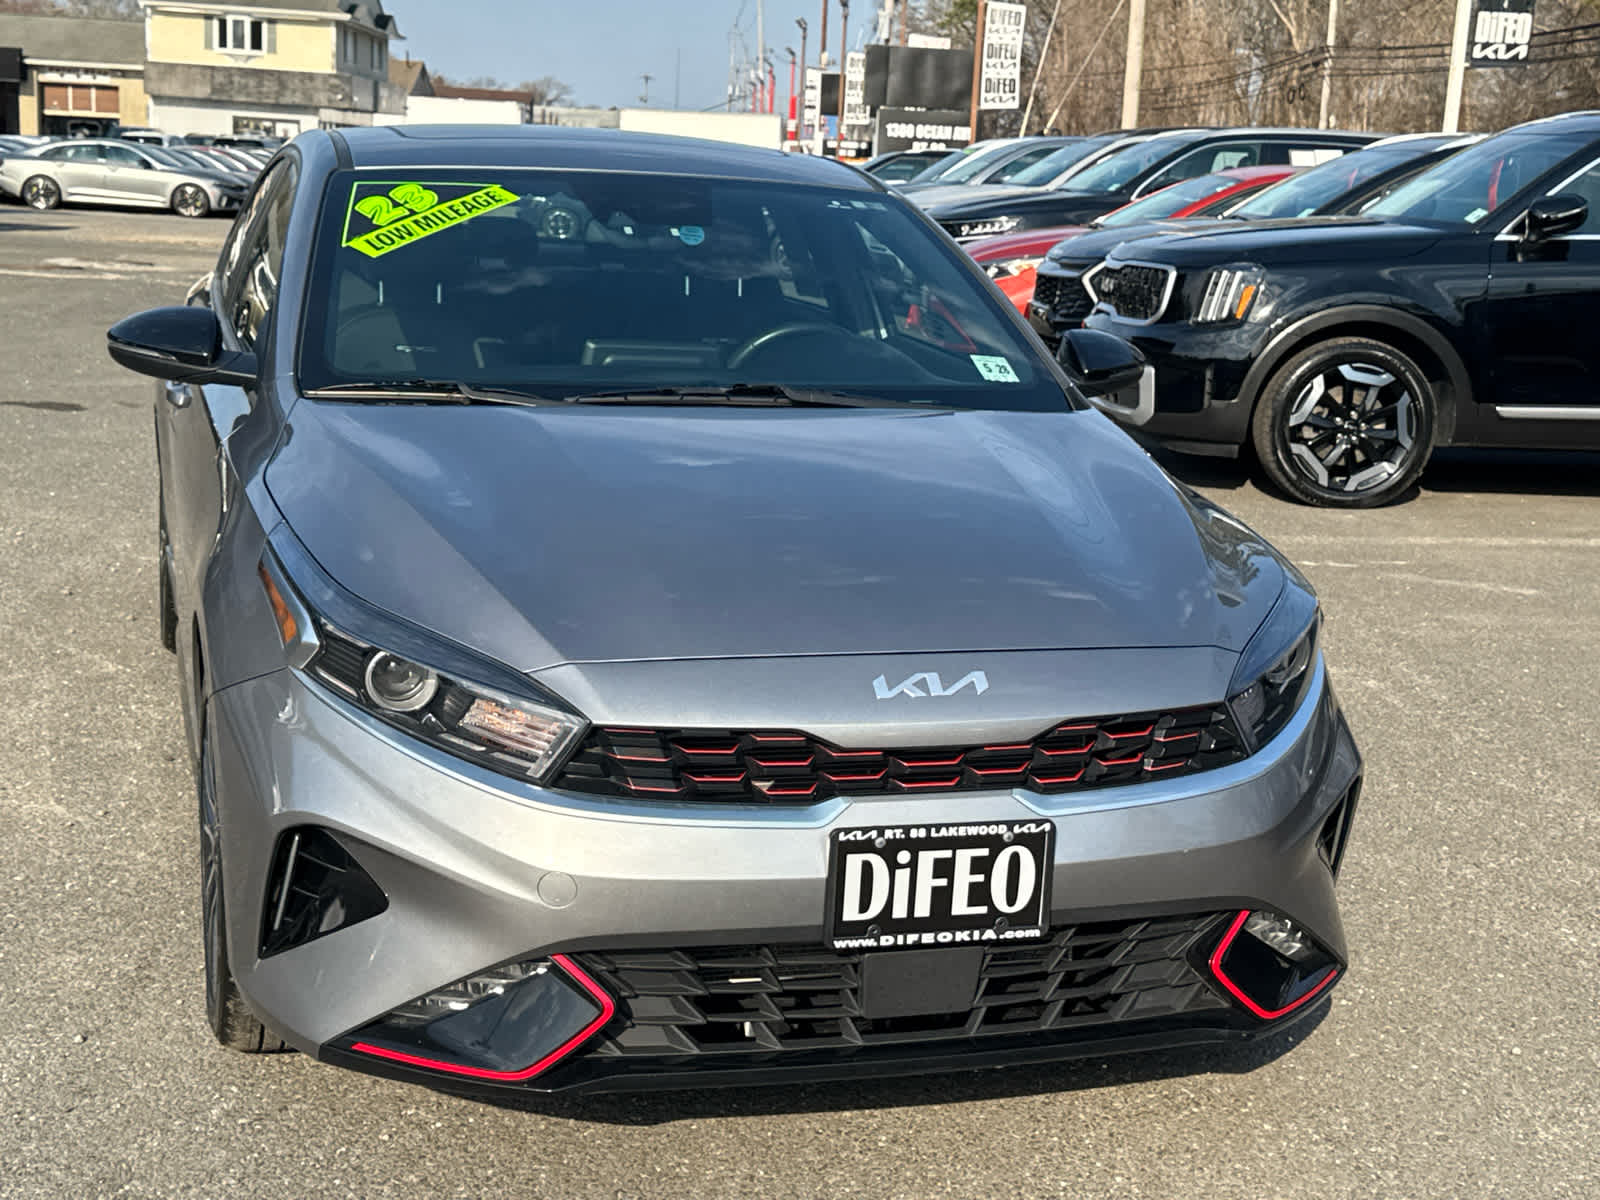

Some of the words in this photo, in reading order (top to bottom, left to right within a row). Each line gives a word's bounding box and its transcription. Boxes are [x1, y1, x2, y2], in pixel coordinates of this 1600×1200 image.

[1472, 43, 1528, 60] KIA
[354, 183, 439, 227] 23
[364, 223, 415, 251] LOW
[411, 189, 504, 232] MILEAGE
[872, 670, 990, 700] KIA
[884, 828, 906, 840] RT.
[909, 827, 927, 839] 88
[930, 823, 1008, 838] LAKEWOOD
[842, 845, 1036, 922] DiFEO
